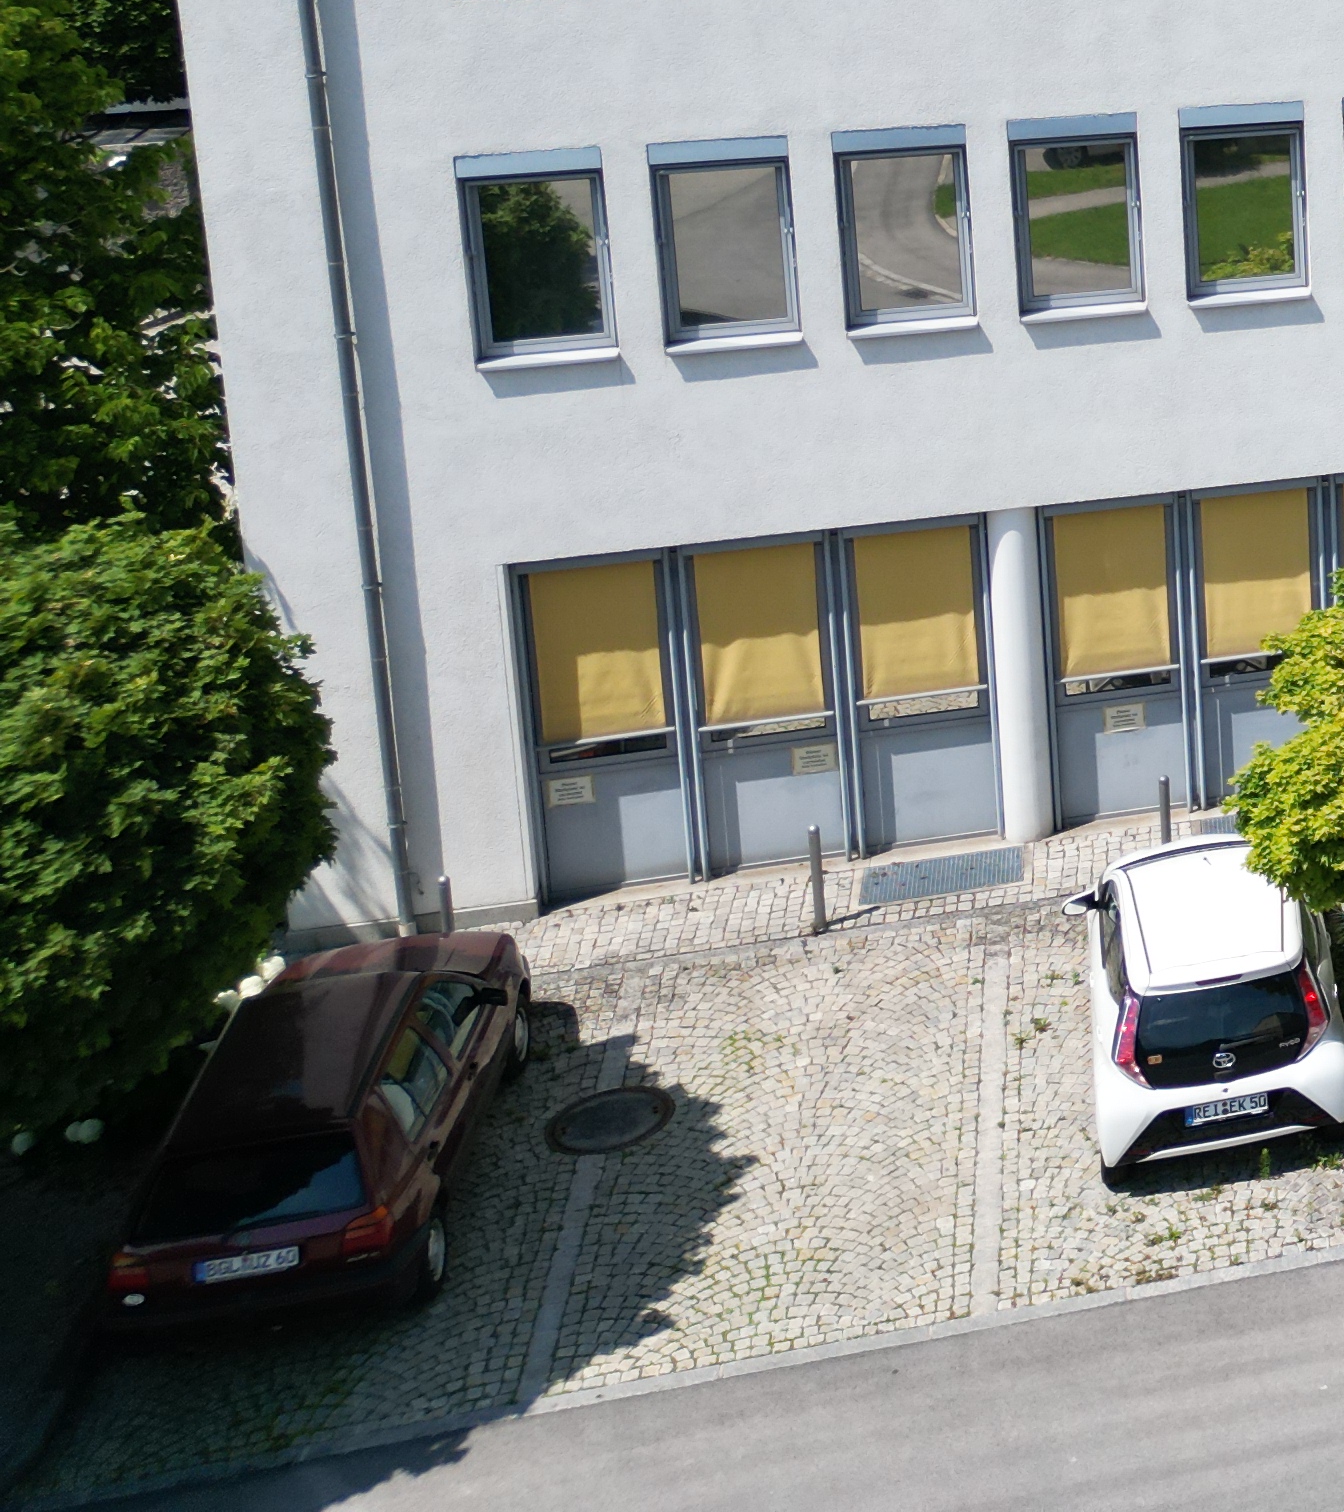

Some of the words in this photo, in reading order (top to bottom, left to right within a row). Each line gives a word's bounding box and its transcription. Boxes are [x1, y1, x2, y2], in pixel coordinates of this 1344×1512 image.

[1193, 1103, 1220, 1120] REI
[1229, 1098, 1247, 1114] EK
[1250, 1095, 1267, 1110] 50
